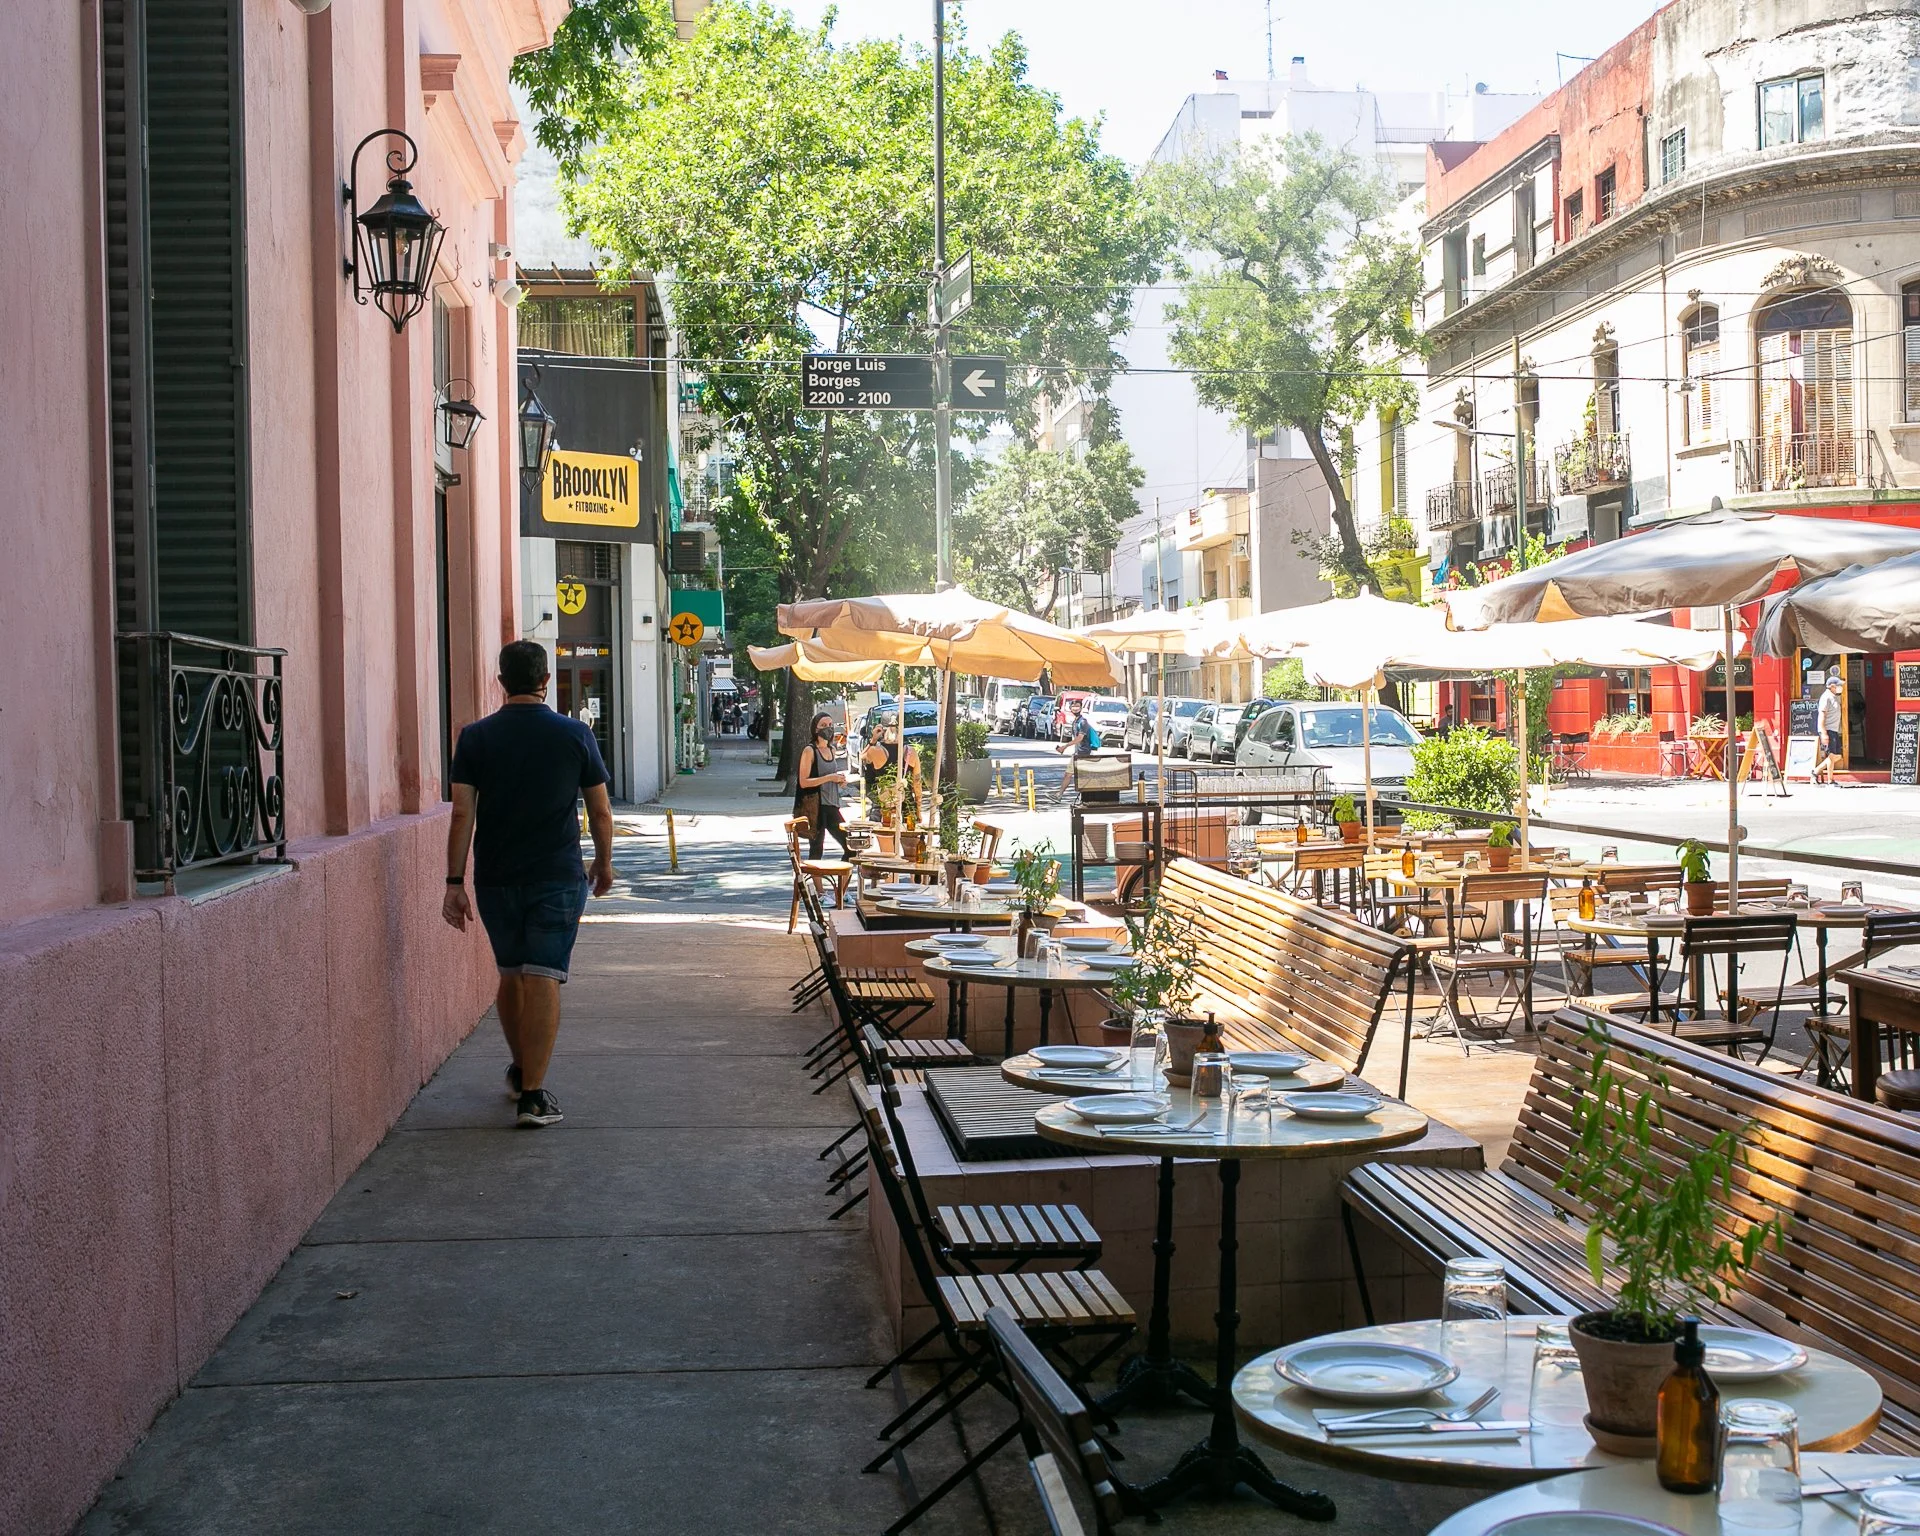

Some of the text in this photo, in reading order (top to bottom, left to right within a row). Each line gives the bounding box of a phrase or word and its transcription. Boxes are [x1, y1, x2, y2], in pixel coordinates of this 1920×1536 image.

[808, 357, 886, 373] Jorge Luis
[808, 373, 861, 390] Borges
[809, 391, 845, 404] 2200
[857, 391, 891, 405] 2100
[552, 458, 629, 506] BROOKLYN
[575, 501, 608, 514] FITBOXING
